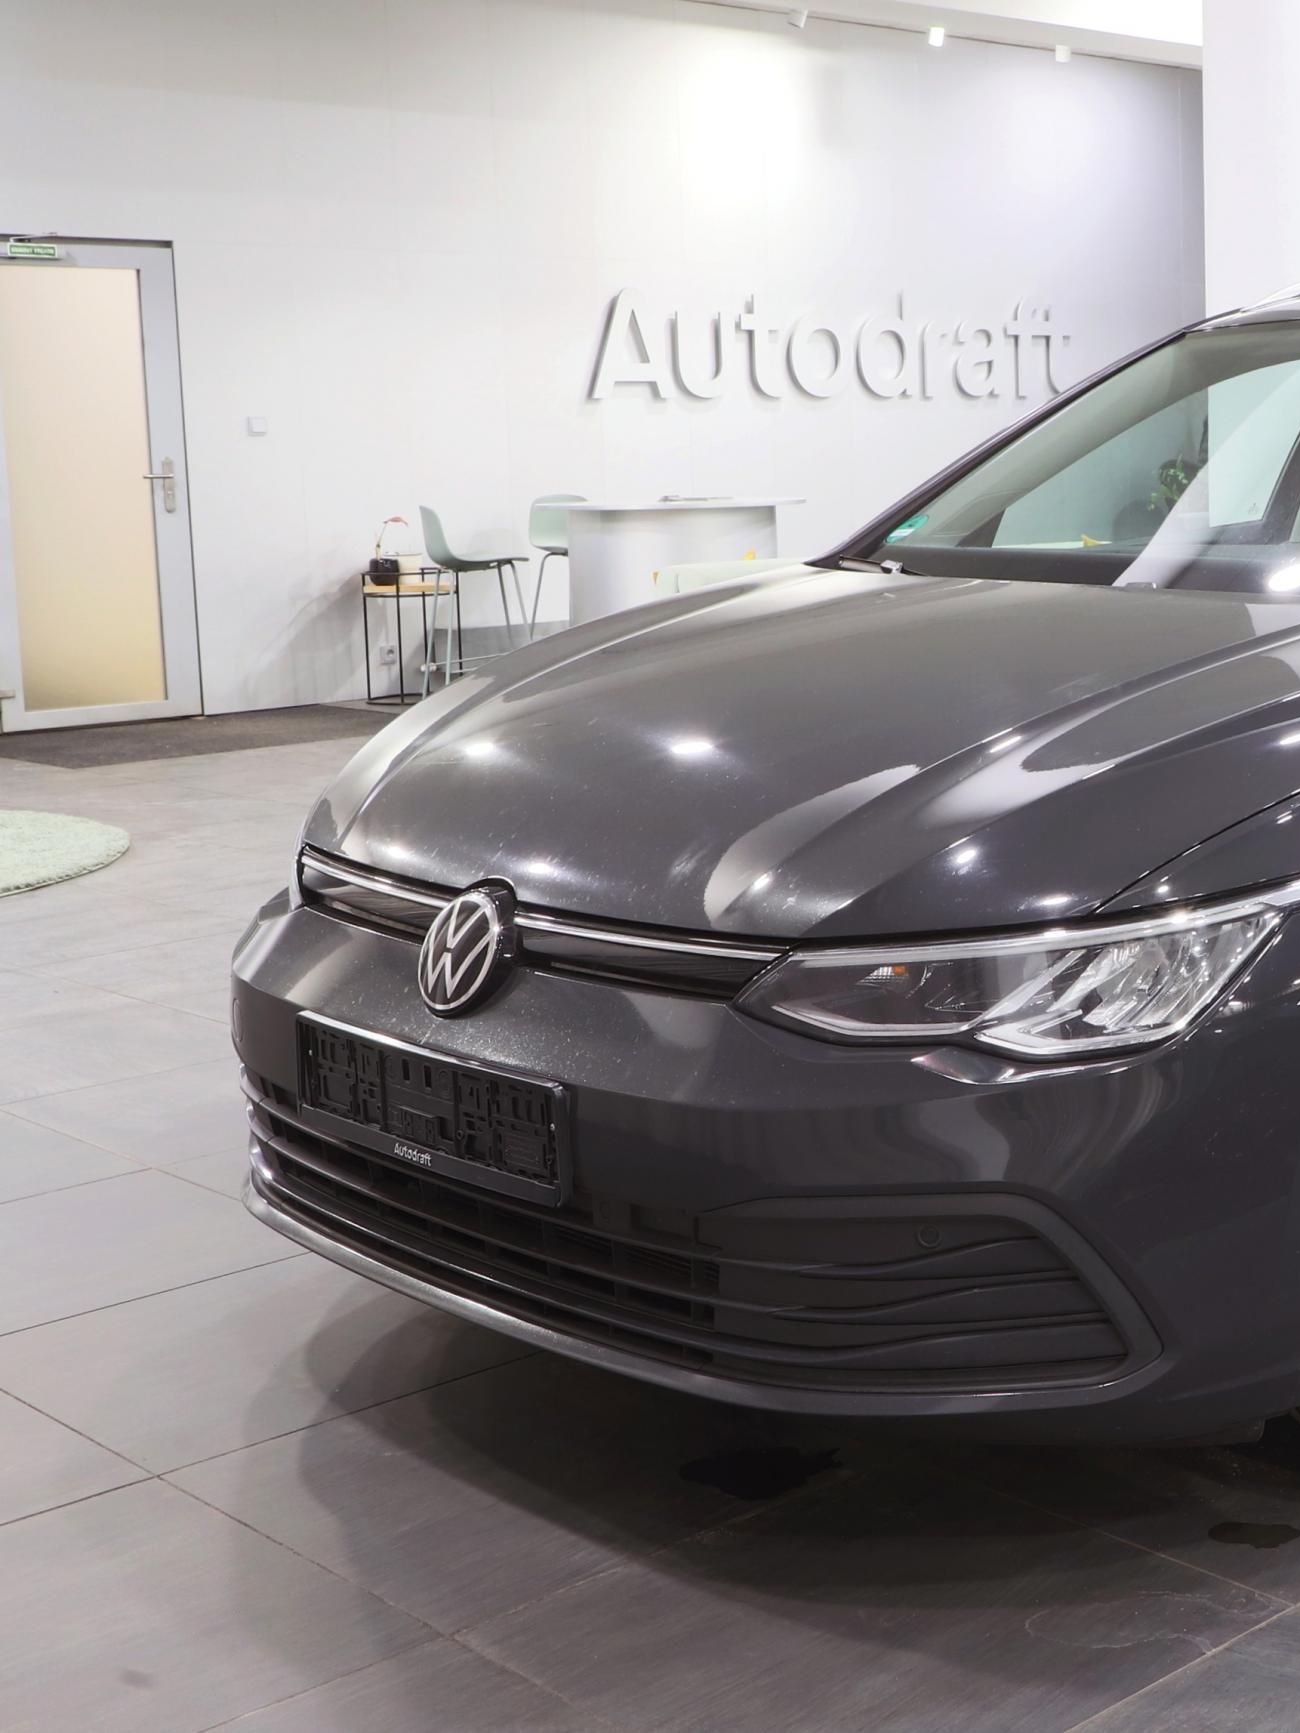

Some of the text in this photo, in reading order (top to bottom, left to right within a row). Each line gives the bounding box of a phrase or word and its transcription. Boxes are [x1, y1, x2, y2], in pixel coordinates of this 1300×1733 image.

[586, 286, 1071, 402] Autodraft
[421, 890, 495, 1005] VW
[394, 1143, 432, 1167] Autodraft
